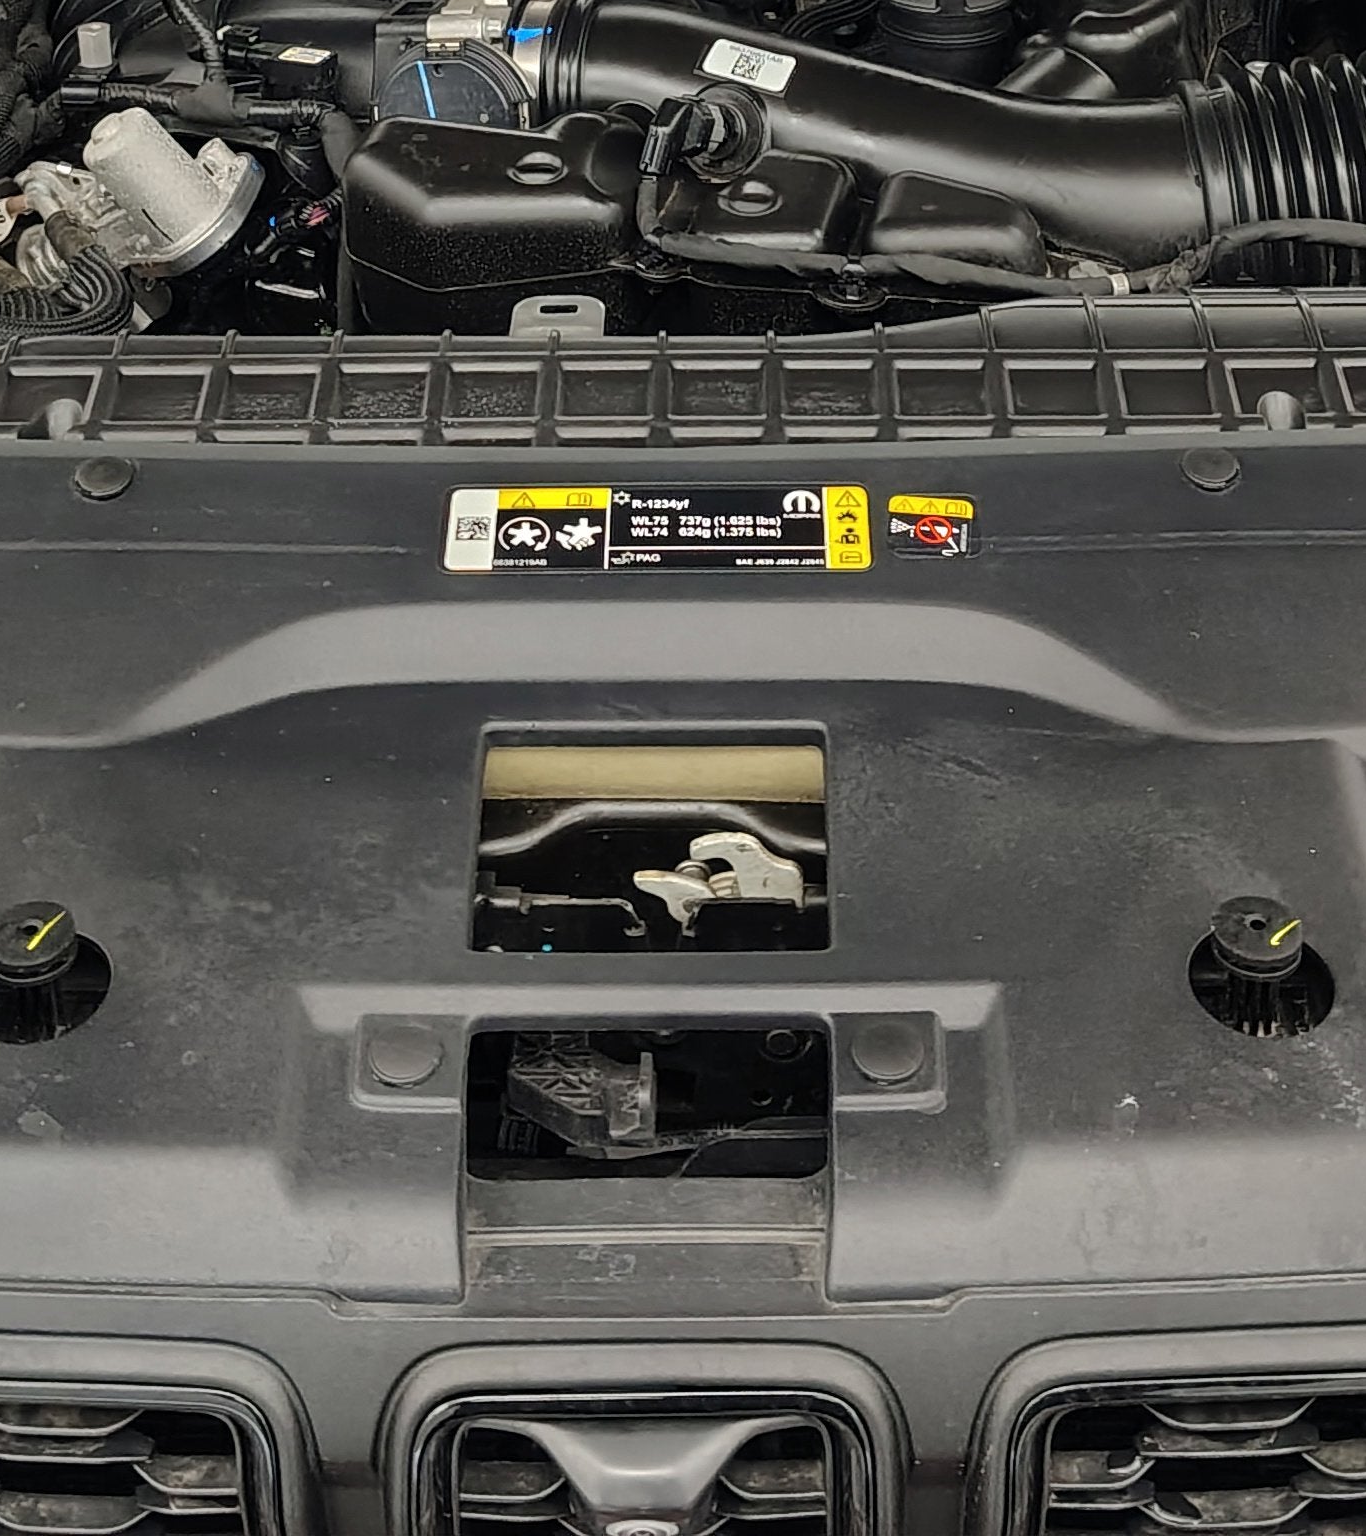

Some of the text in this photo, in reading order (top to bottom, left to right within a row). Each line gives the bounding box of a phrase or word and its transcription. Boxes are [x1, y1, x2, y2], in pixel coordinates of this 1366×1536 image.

[632, 499, 690, 510] R-1234yf
[631, 516, 782, 527] WL75 737g (1.625 lbs)
[631, 527, 782, 539] WL74 624g (1.375 lbs)
[636, 553, 661, 562] PAG
